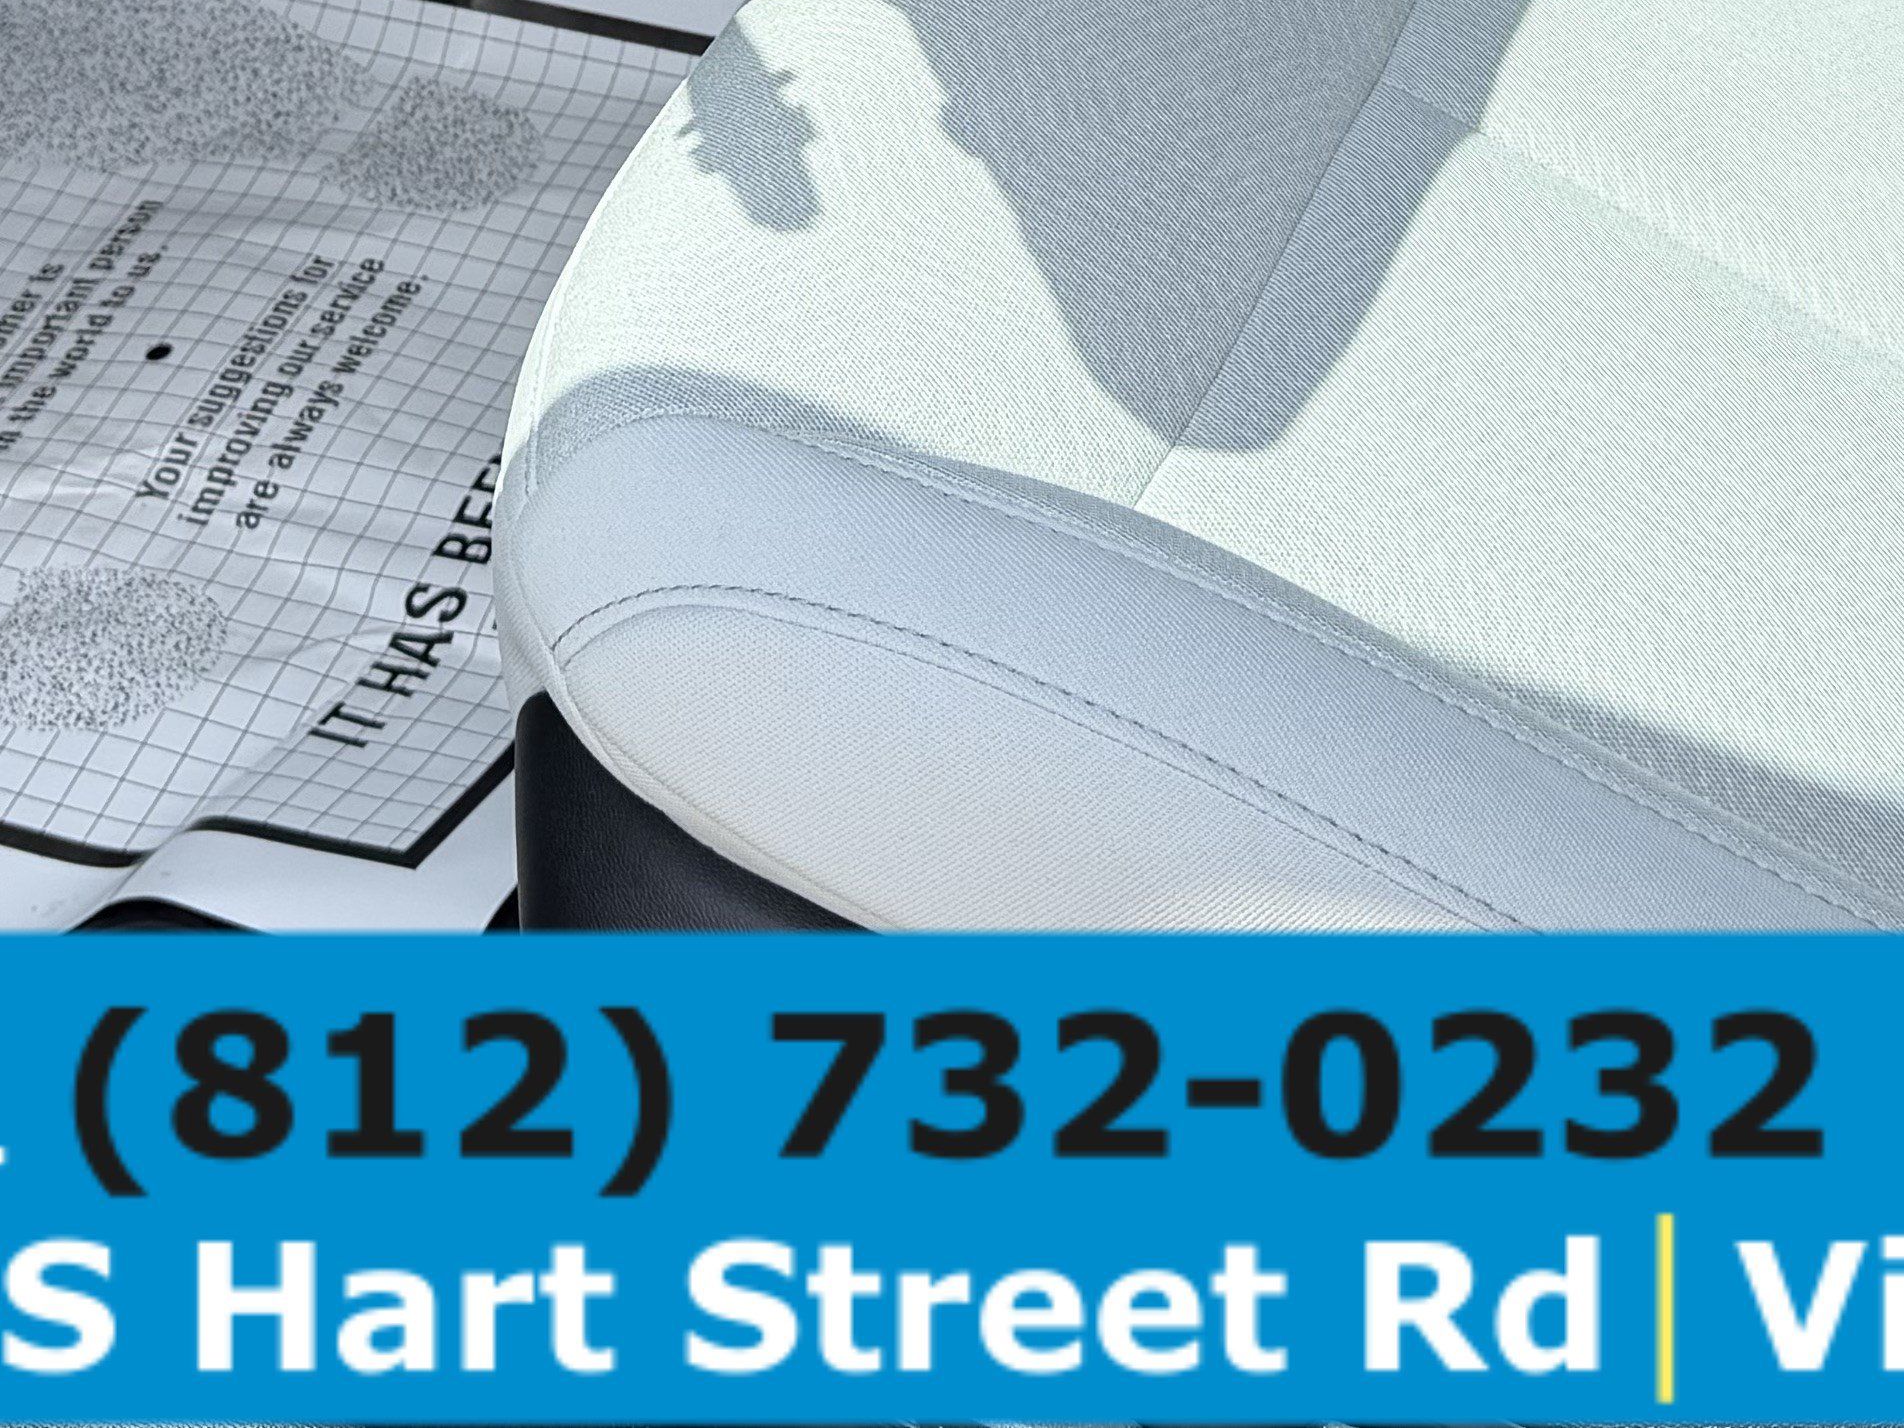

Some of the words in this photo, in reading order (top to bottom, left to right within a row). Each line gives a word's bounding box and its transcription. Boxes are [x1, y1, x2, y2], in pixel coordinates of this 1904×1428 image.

[8, 384, 57, 424] the
[48, 312, 114, 381] world
[99, 283, 137, 309] to
[126, 243, 168, 279] us.
[28, 262, 65, 284] is
[88, 198, 164, 272] person
[135, 430, 199, 501] Your
[187, 288, 309, 428] suggestions
[289, 254, 337, 285] for
[177, 378, 295, 528] improving
[277, 338, 321, 379] our
[309, 256, 386, 339] service
[235, 478, 280, 531] are
[267, 378, 345, 471] always
[331, 274, 429, 375] welcome.
[307, 701, 386, 749] IT
[354, 581, 469, 698] HAS
[431, 454, 502, 565] BE
